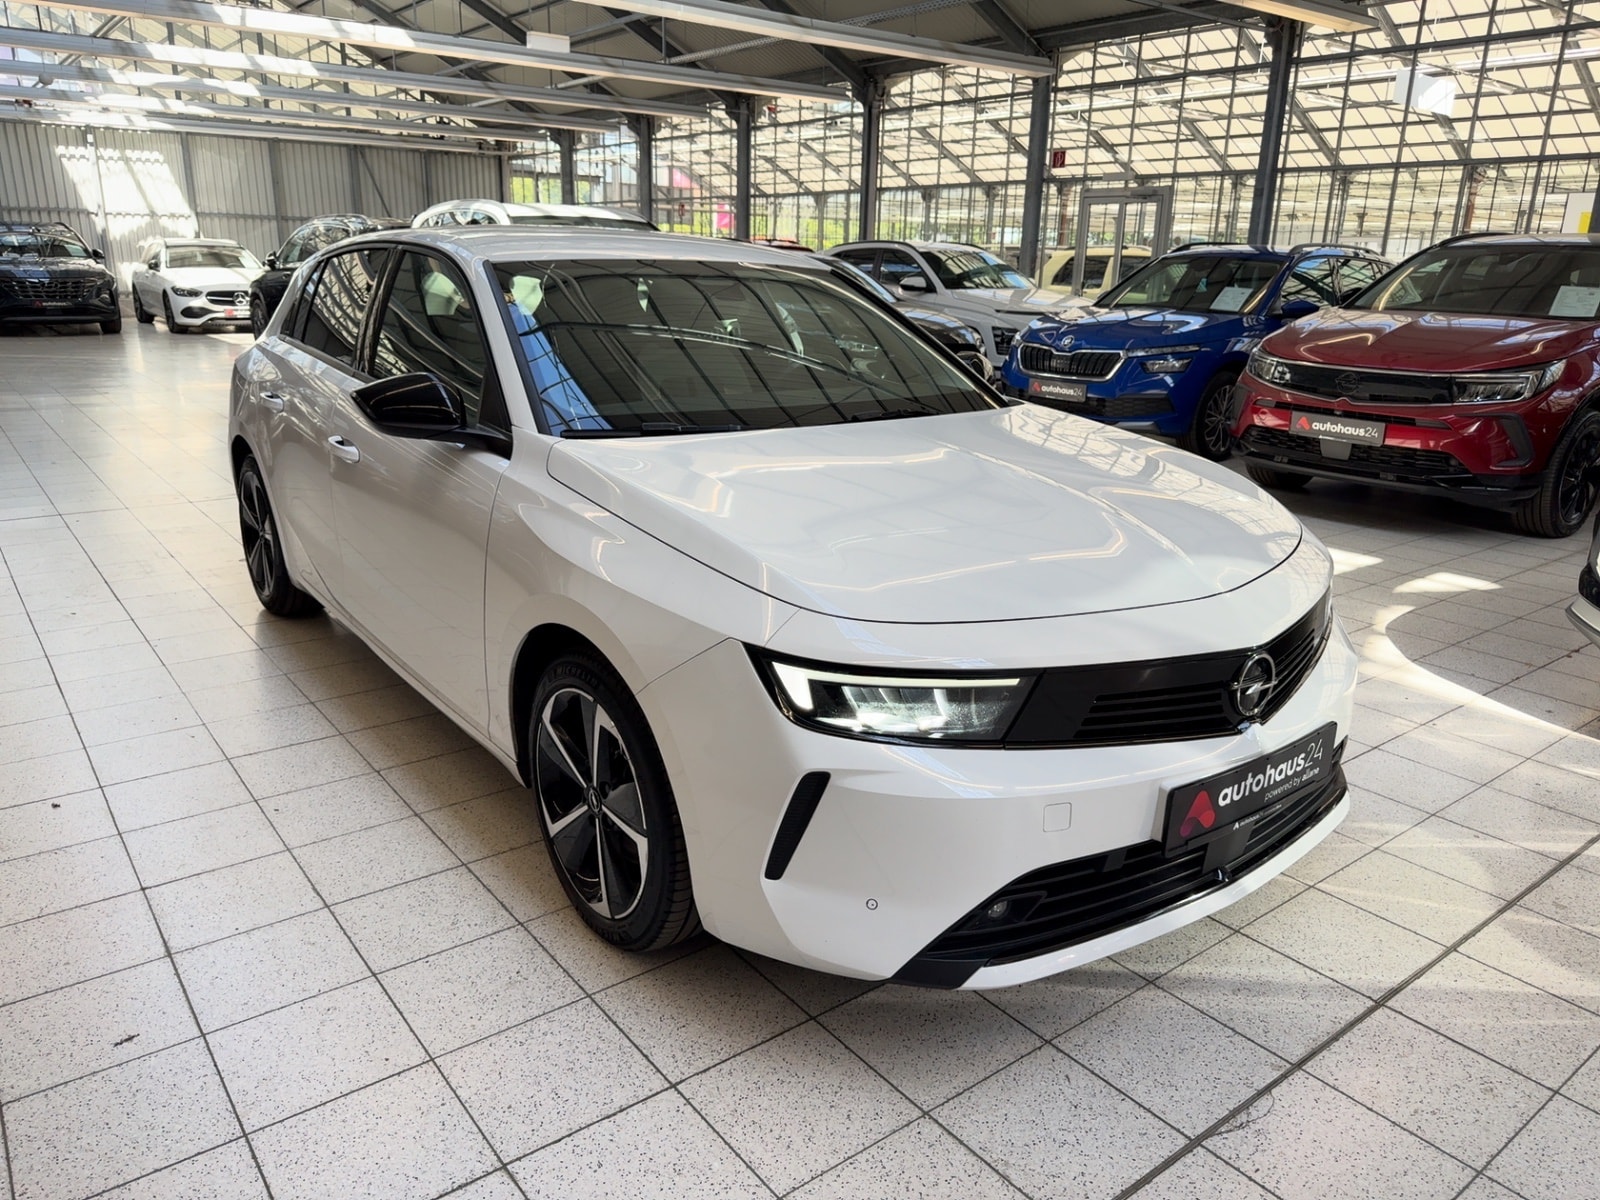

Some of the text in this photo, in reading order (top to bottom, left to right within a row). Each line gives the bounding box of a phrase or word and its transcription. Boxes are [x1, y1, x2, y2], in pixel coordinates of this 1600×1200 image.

[1041, 384, 1082, 396] autohaus24
[1311, 421, 1378, 438] autohaus24
[1218, 739, 1323, 807] autohaus24
[1264, 781, 1293, 803] powered
